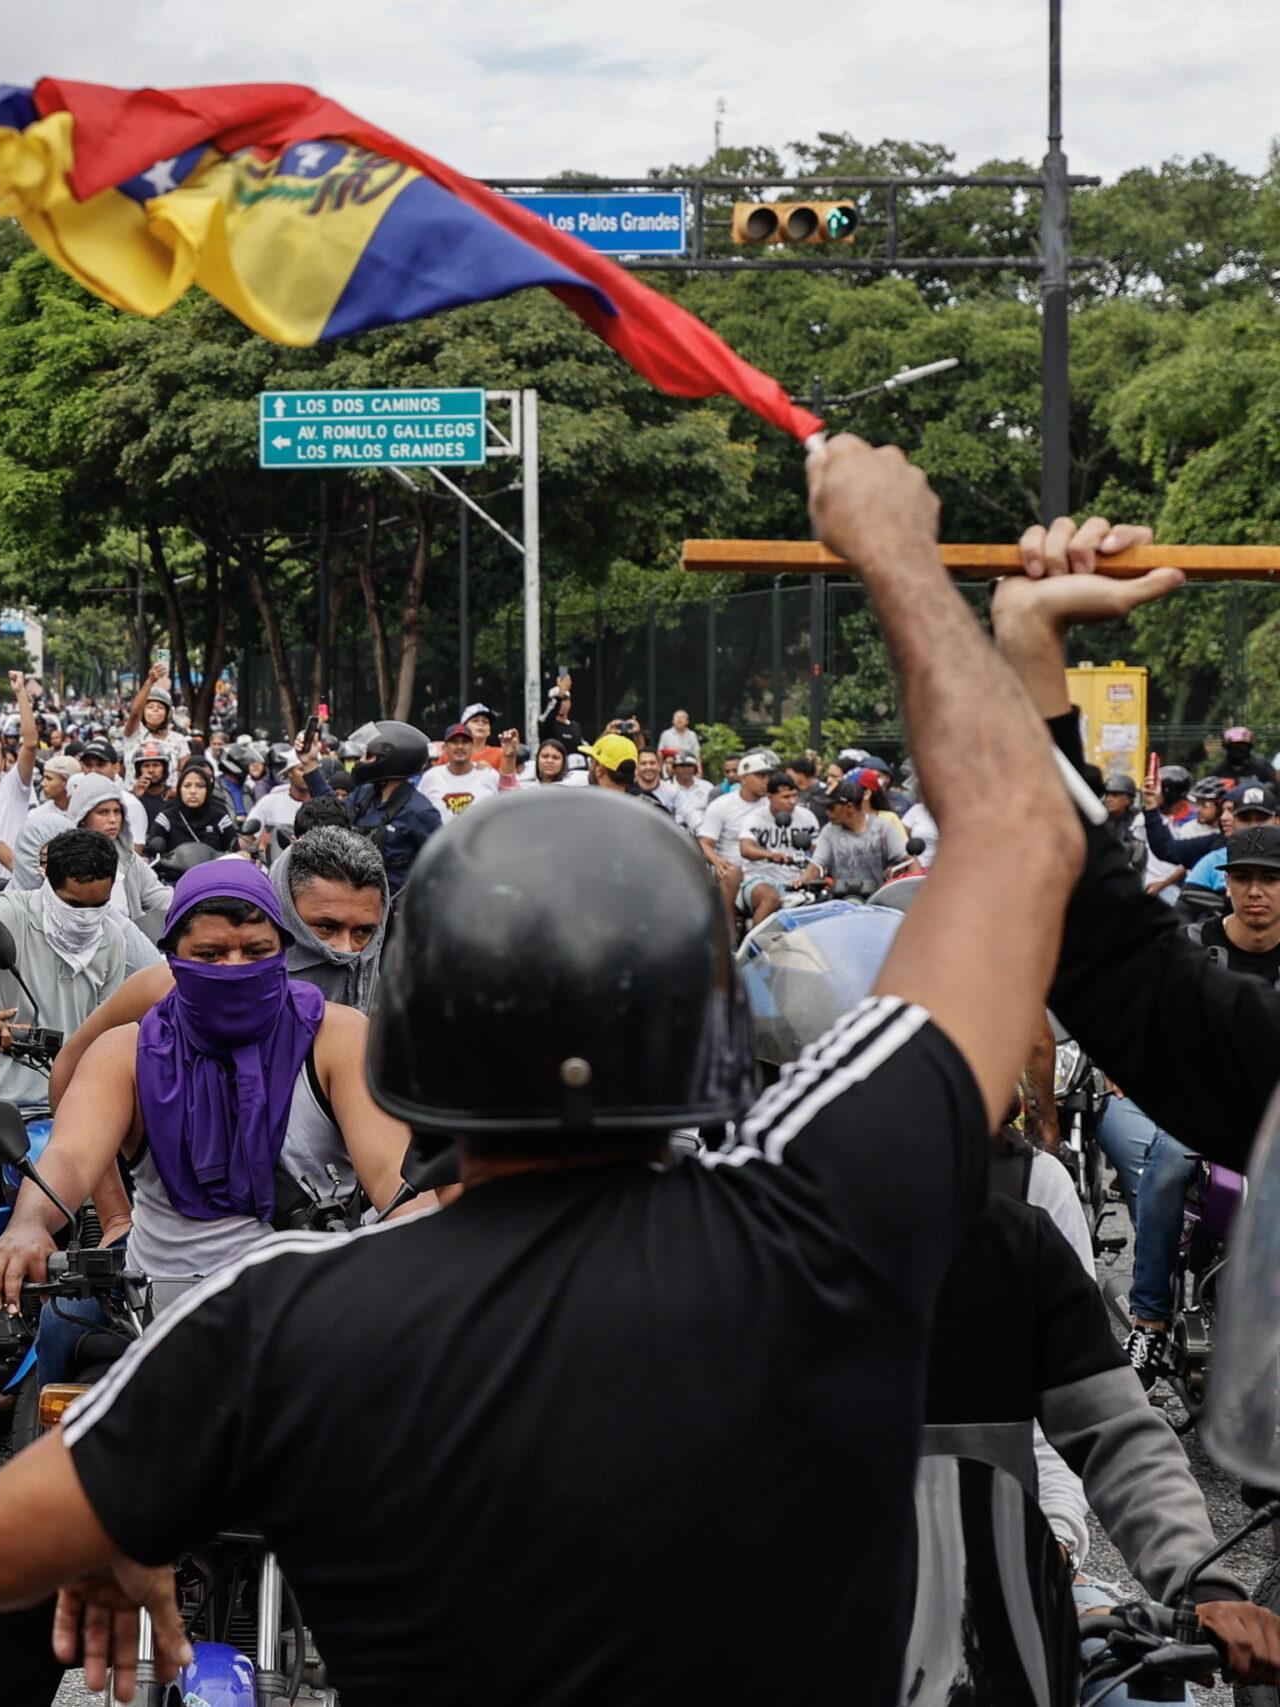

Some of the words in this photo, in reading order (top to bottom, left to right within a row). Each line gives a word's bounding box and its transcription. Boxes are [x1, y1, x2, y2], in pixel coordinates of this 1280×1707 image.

[548, 212, 575, 231] Los
[578, 212, 618, 232] Palos
[620, 211, 680, 231] Grandes
[296, 399, 326, 414] LOS
[332, 398, 364, 414] DOS
[371, 397, 441, 413] CAMINOS
[297, 425, 318, 440] AV.
[323, 424, 387, 440] ROMULO
[393, 422, 476, 439] GALLEGOS
[297, 445, 327, 459] LOS
[333, 444, 383, 459] PALOS
[389, 443, 465, 458] GRANDES
